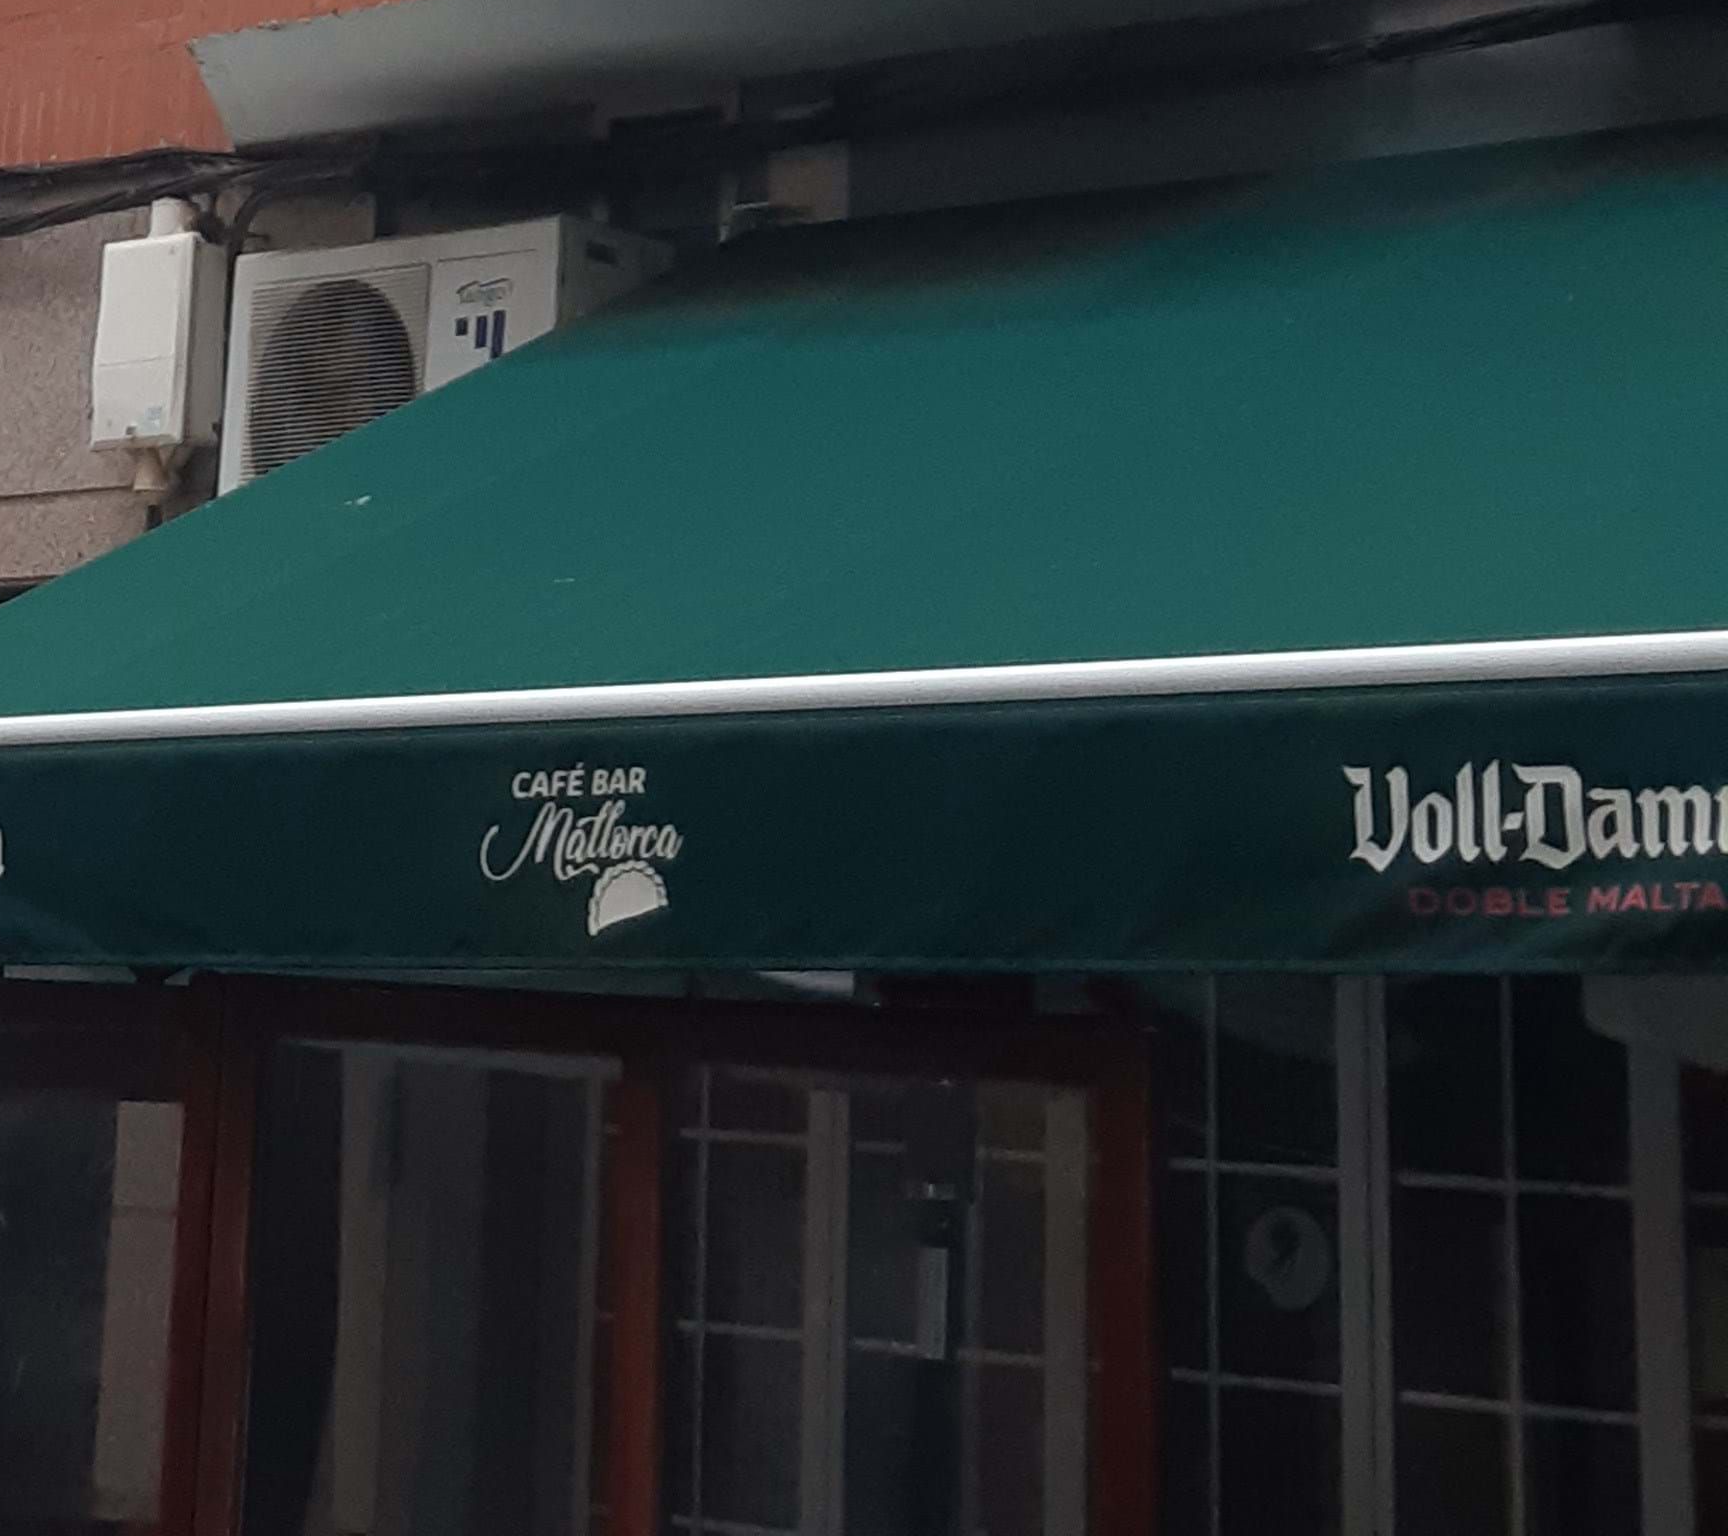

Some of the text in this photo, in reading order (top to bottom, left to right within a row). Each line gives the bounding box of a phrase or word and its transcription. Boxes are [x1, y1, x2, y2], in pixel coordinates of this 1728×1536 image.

[512, 762, 647, 798] CAFÉ BAR
[1343, 759, 1728, 873] Voll-Dam
[1409, 882, 1727, 917] DOBLE MALTA
